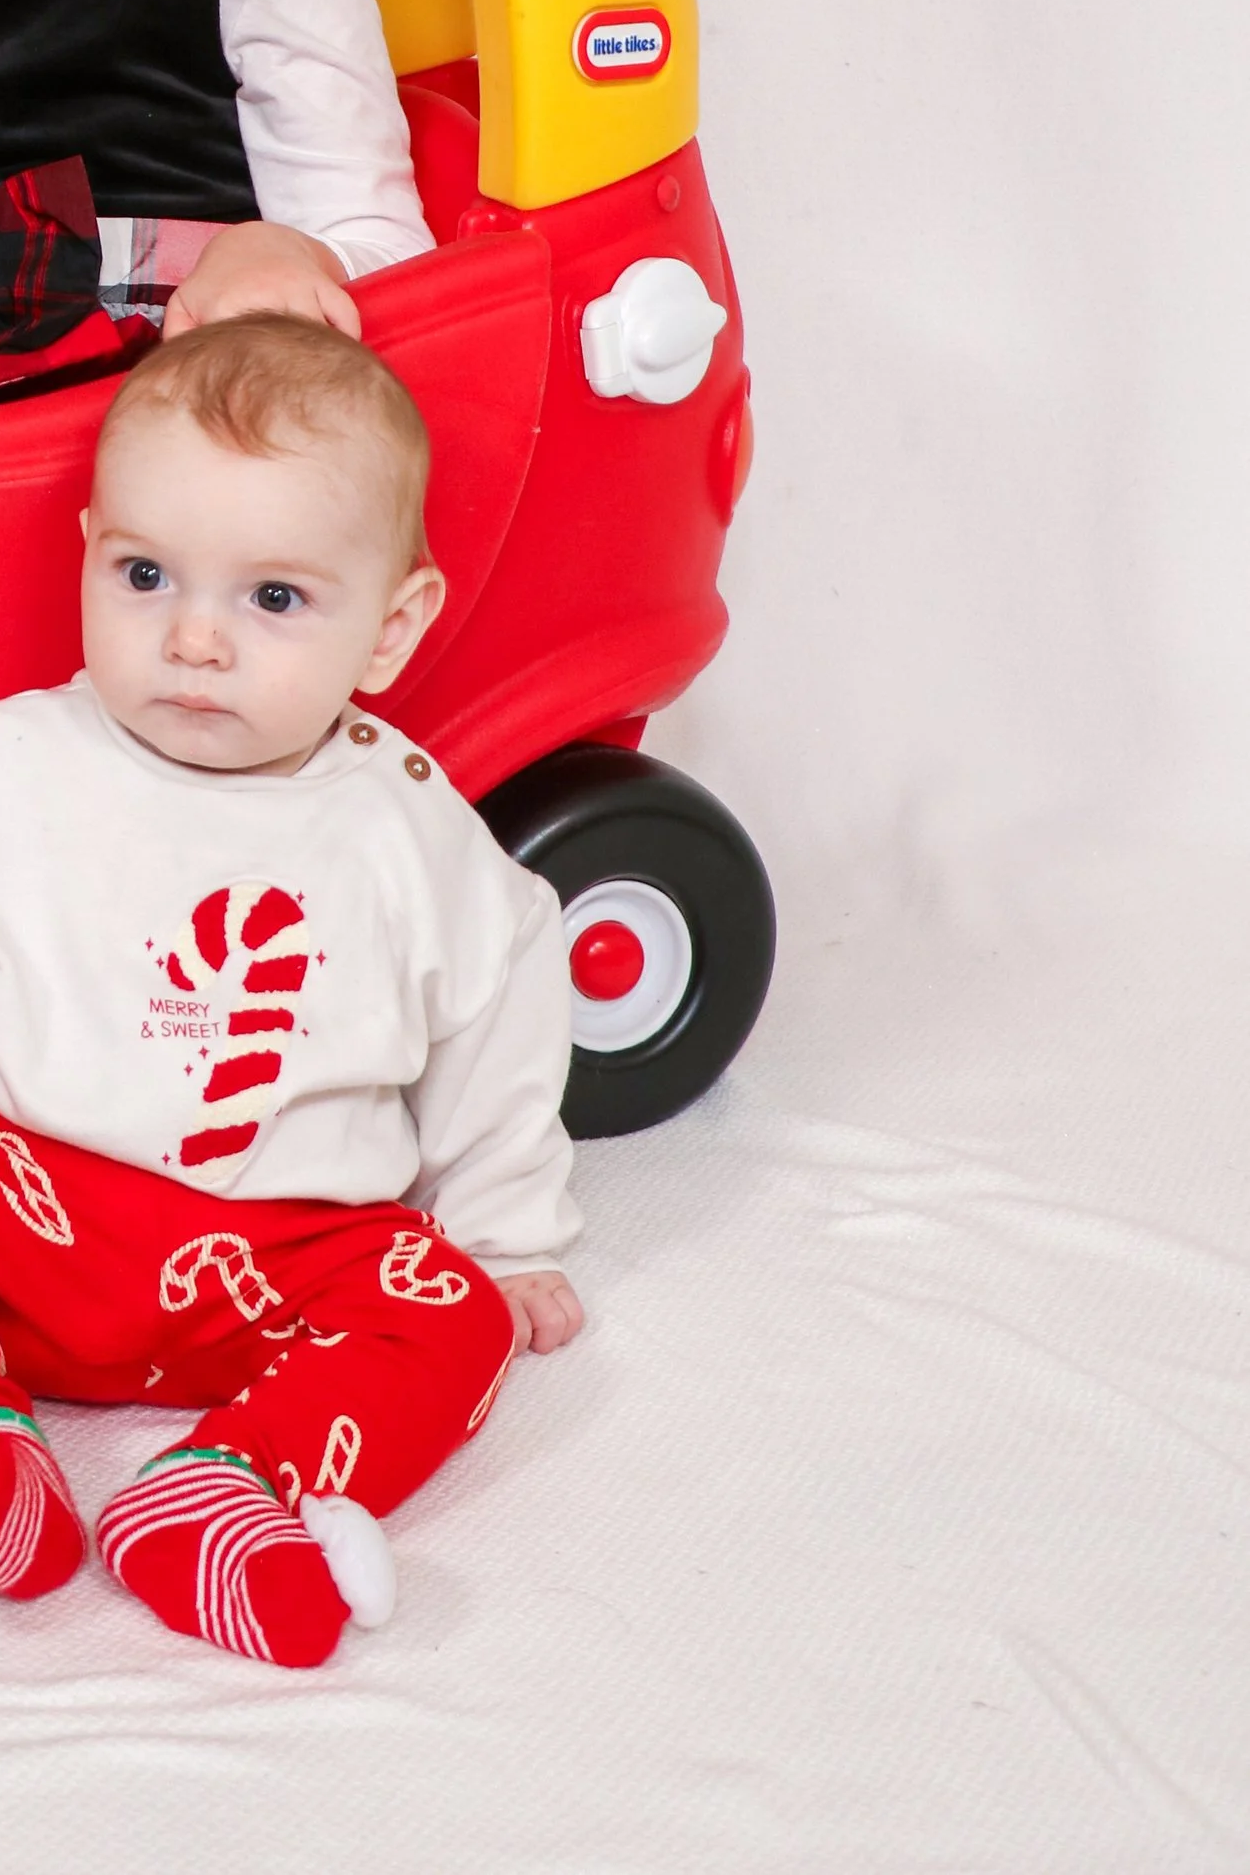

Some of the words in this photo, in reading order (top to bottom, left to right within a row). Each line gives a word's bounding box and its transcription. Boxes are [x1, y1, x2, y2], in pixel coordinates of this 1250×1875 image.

[593, 37, 622, 55] little
[149, 997, 210, 1018] MERRY
[141, 1020, 154, 1039] &
[161, 1020, 220, 1038] SWEET
